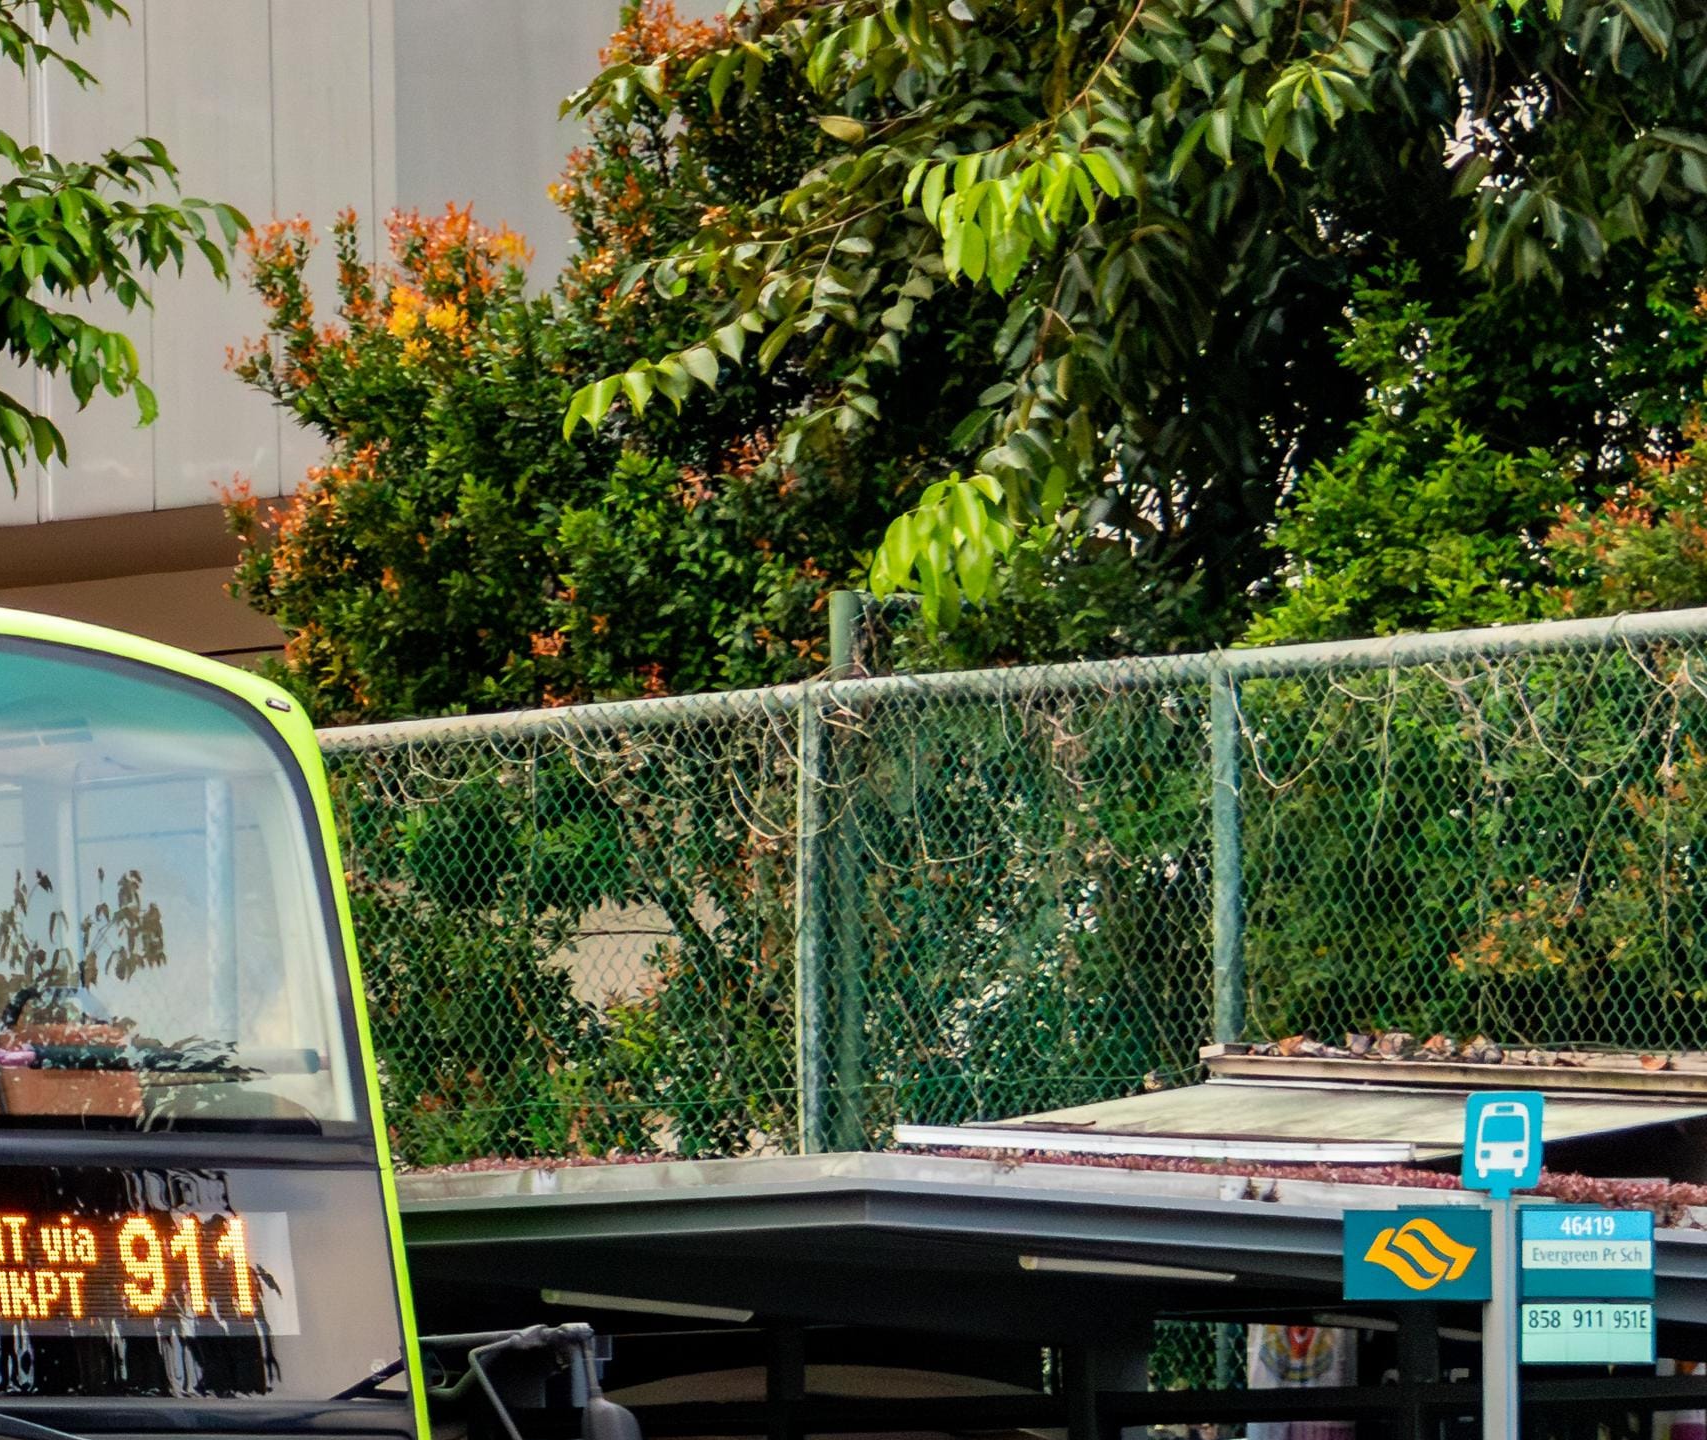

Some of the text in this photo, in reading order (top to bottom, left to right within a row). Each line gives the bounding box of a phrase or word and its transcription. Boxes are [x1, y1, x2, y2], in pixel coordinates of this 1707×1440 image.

[1559, 1215, 1616, 1236] 46419
[40, 1215, 96, 1265] via
[116, 1213, 256, 1317] 911
[1532, 1246, 1643, 1265] Evergreen Pr Sch
[1528, 1309, 1648, 1329] 858 911 951E
